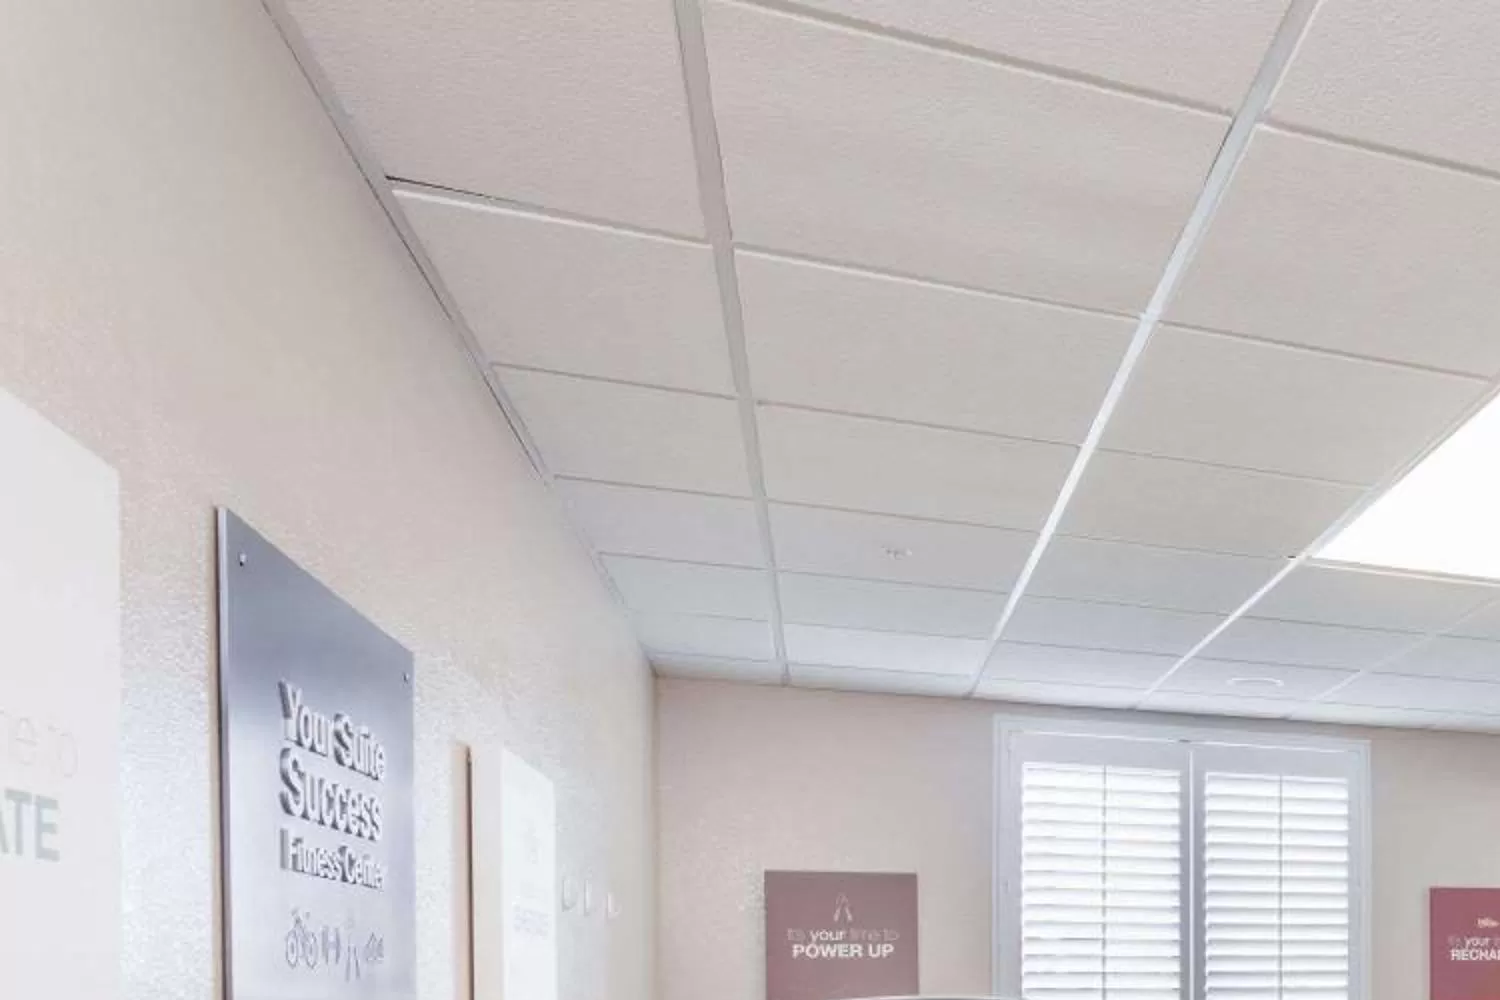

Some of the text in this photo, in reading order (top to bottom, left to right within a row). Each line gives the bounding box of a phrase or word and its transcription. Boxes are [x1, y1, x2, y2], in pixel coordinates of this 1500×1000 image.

[278, 678, 386, 782] Your Suite
[280, 747, 384, 843] Success
[280, 828, 386, 892] Fitness Center
[792, 942, 896, 960] POWER UP
[809, 929, 846, 944] your
[1464, 936, 1491, 949] your
